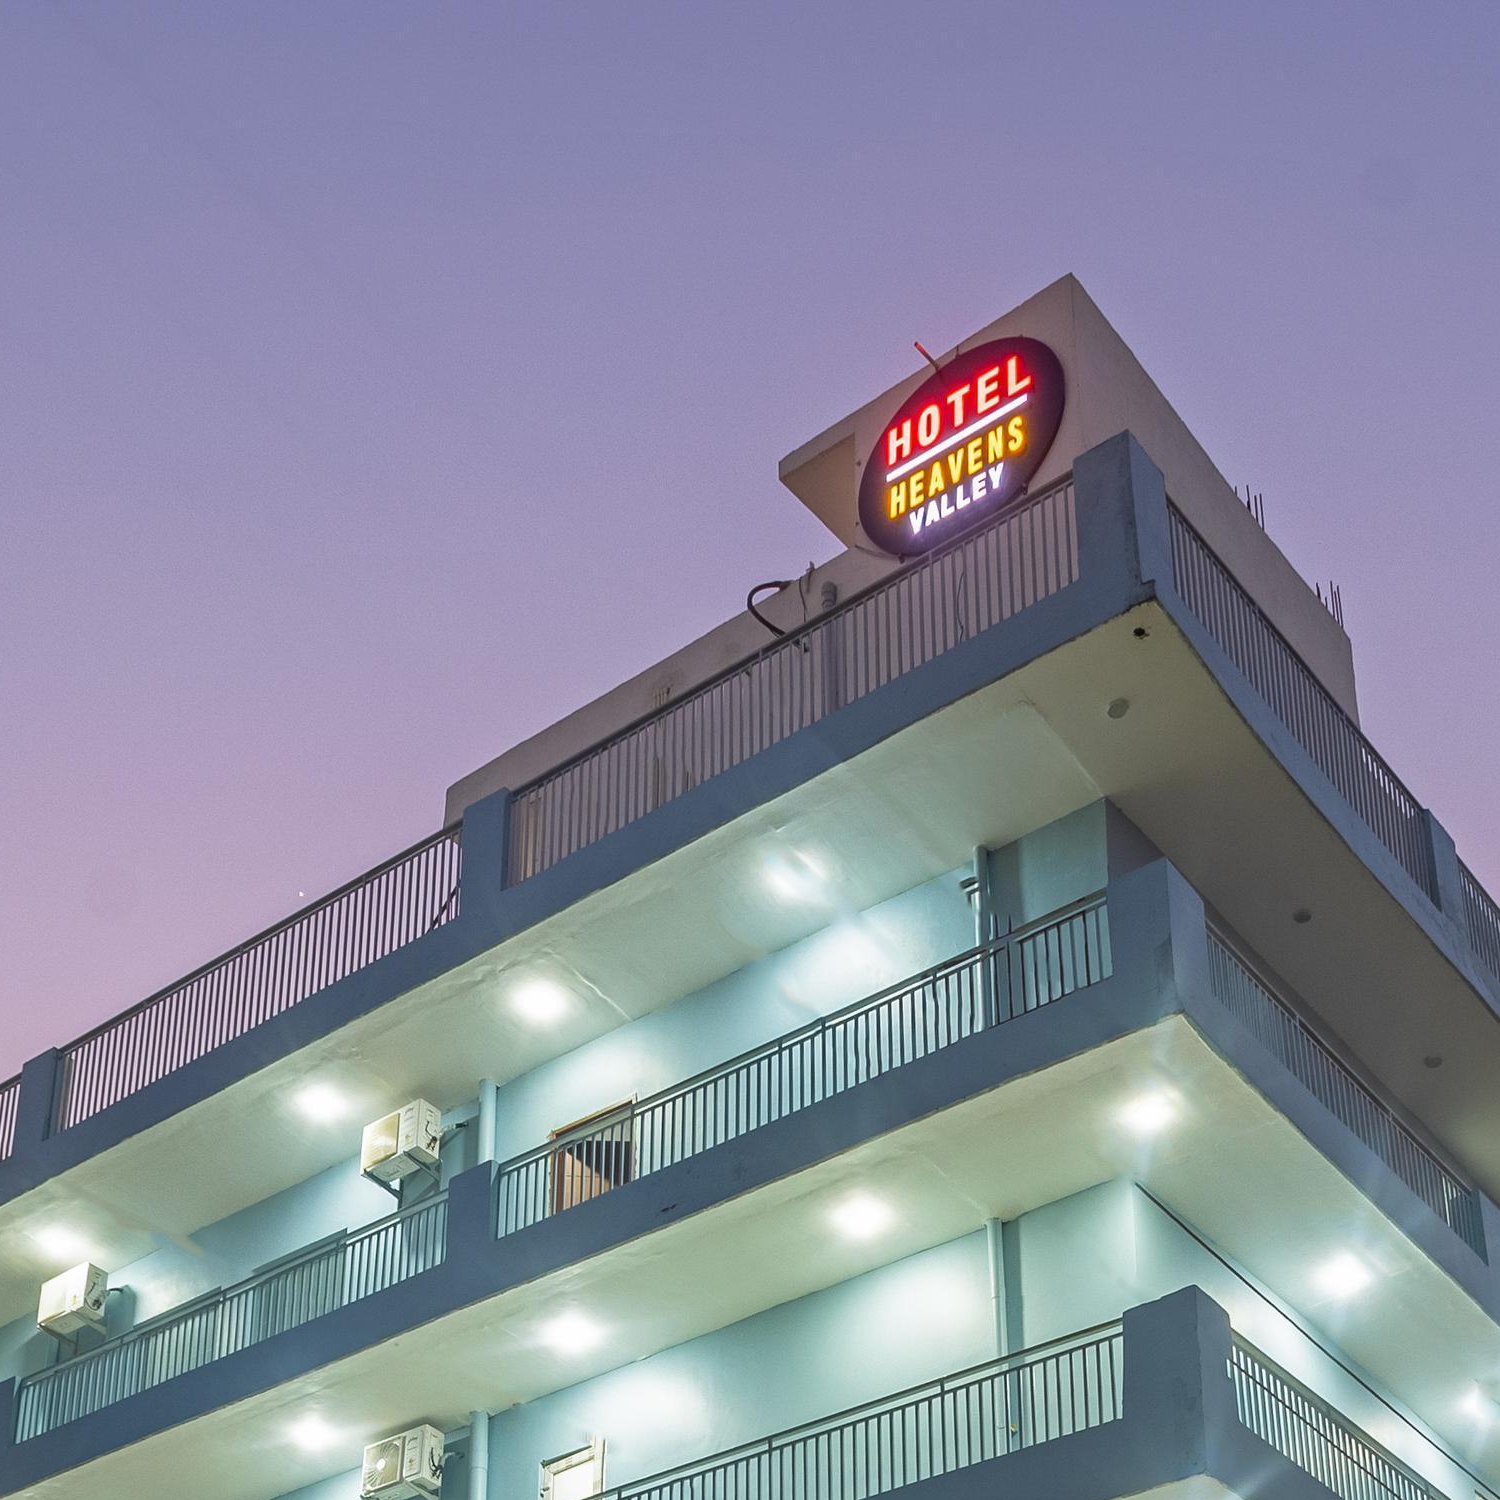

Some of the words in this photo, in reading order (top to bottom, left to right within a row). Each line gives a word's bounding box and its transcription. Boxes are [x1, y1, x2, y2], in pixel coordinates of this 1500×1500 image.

[887, 355, 1032, 466] HOTEL
[889, 415, 1024, 519] HEAVENS
[909, 462, 1005, 535] VALLEY
